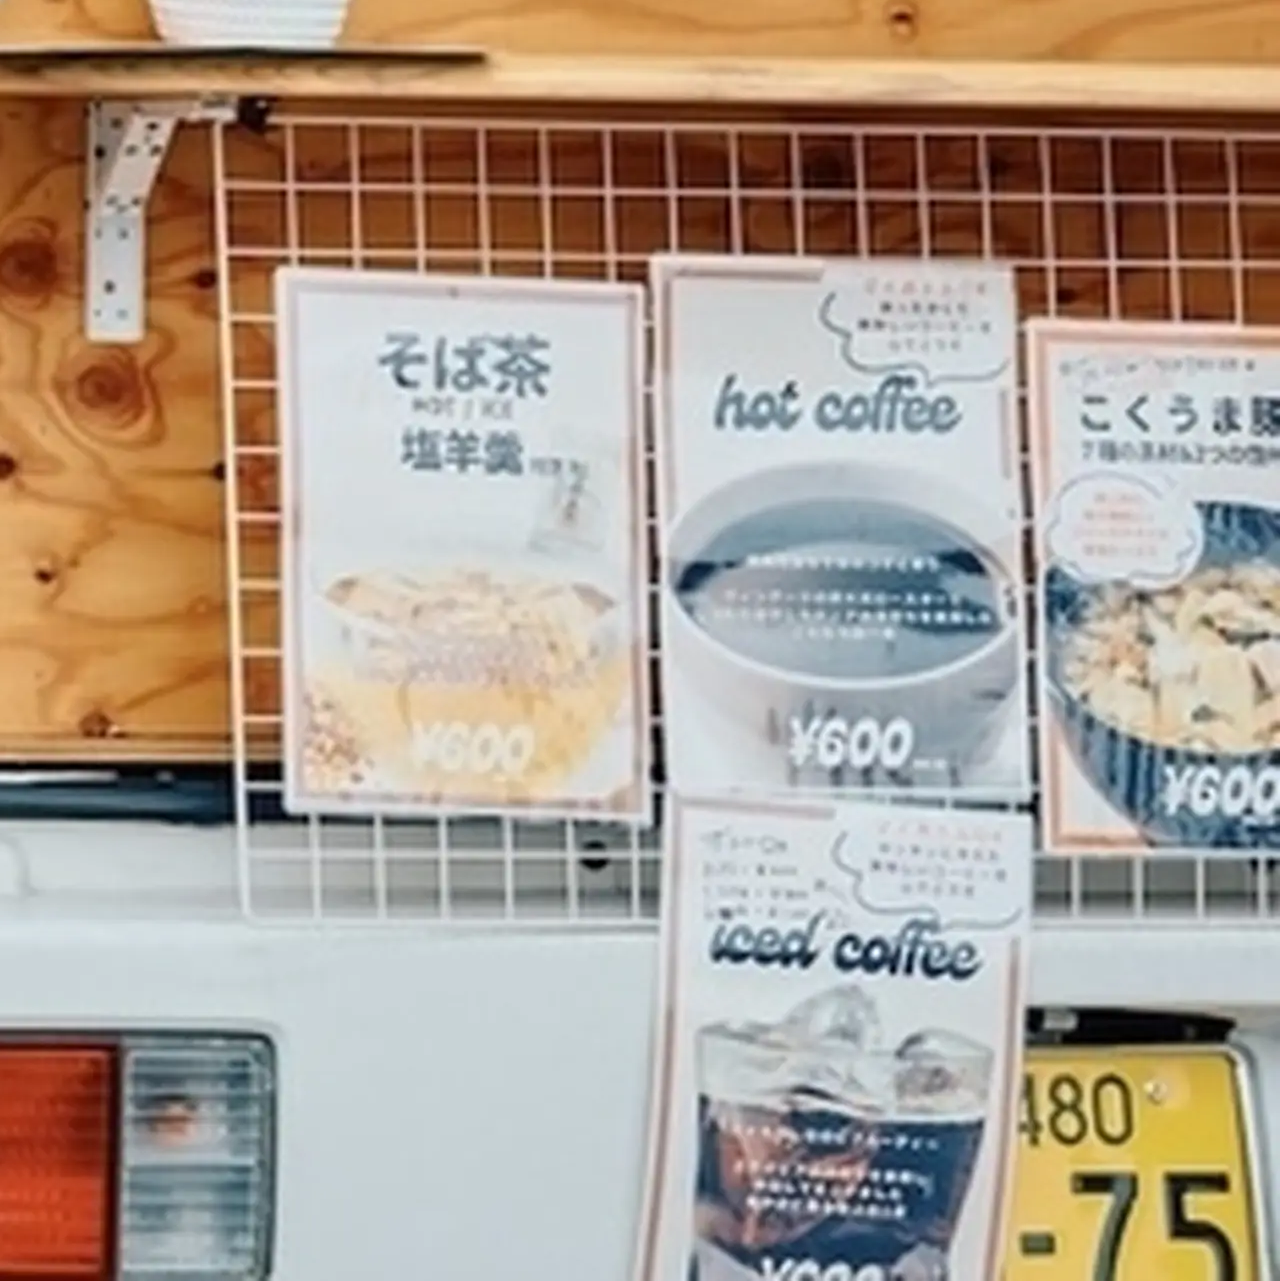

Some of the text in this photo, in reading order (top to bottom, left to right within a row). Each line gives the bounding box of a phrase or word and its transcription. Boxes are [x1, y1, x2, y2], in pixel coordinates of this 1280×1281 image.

[377, 331, 552, 398] そば茶
[714, 371, 965, 436] hot coffee
[410, 722, 537, 775] ¥600
[789, 715, 916, 772] ¥600
[1162, 764, 1280, 817] ¥600
[711, 911, 982, 981] iced coffee
